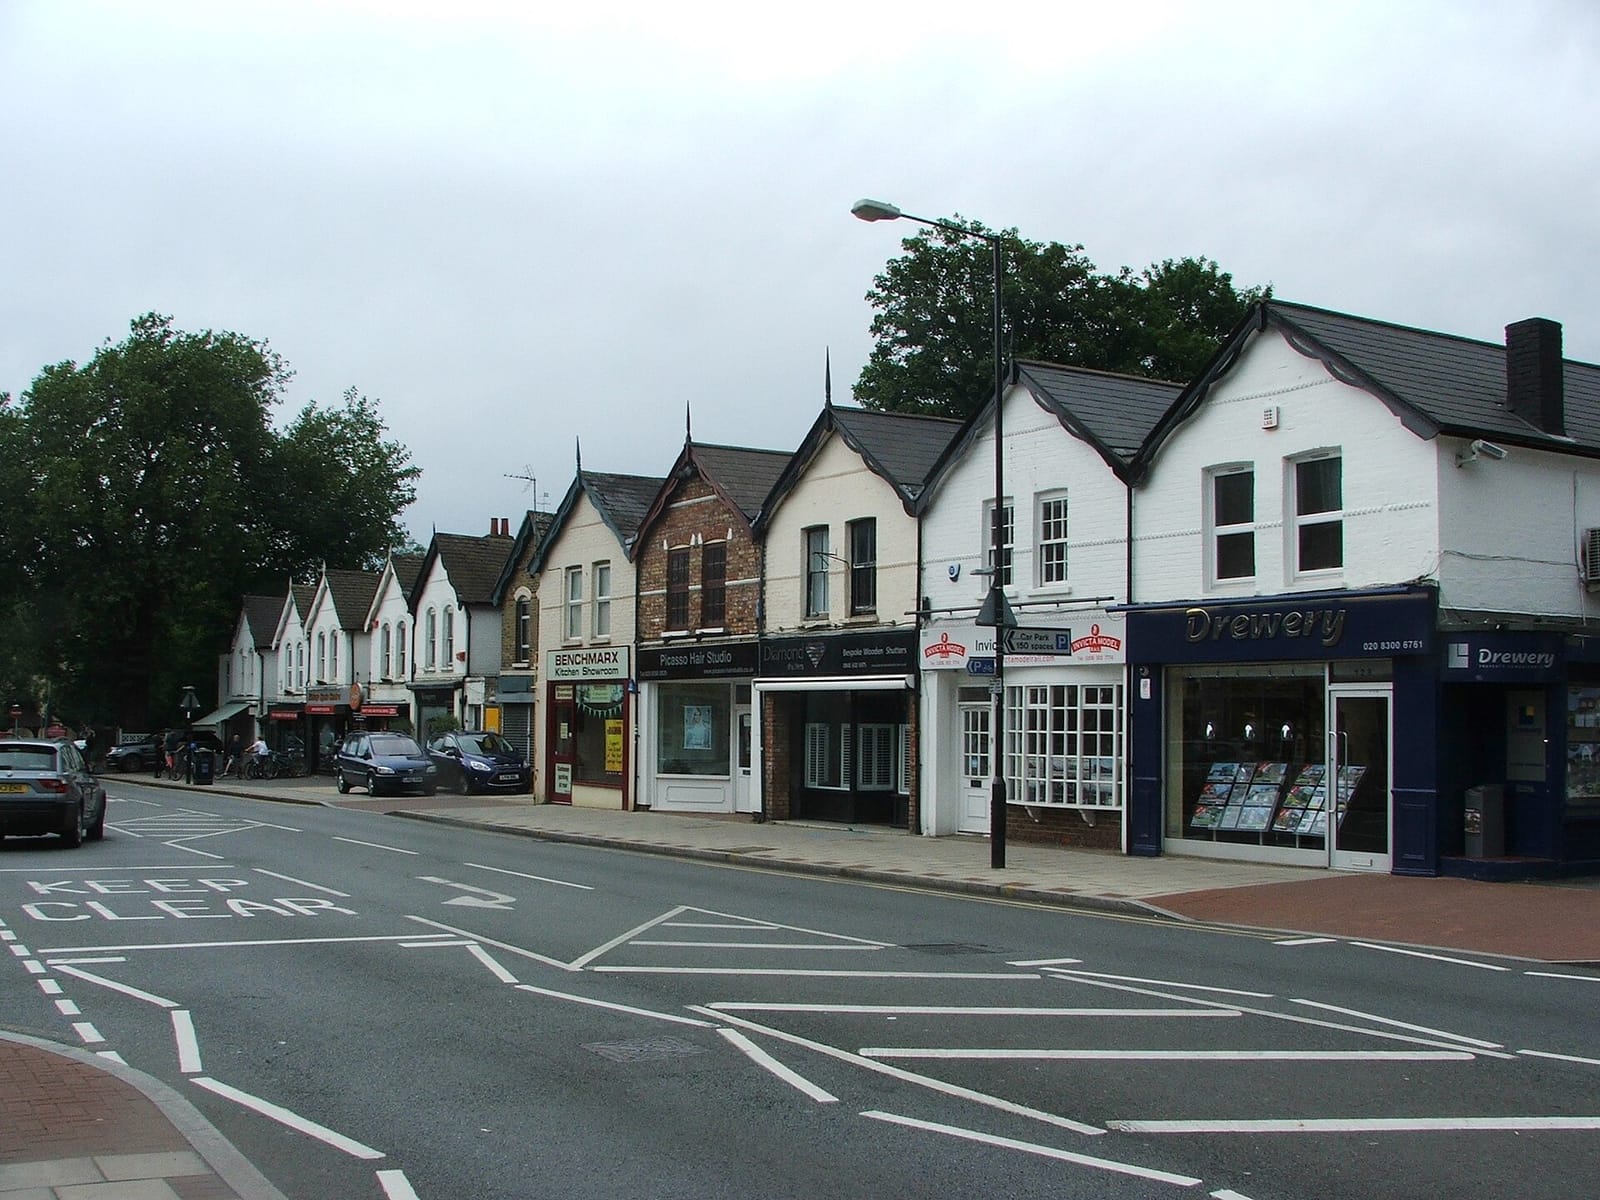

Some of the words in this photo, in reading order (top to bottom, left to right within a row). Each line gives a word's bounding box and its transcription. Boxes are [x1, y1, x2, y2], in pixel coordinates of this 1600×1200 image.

[1185, 607, 1347, 647] Drewery
[1016, 642, 1028, 650] 150
[1031, 642, 1054, 651] spaces
[1072, 637, 1096, 650] INVICTA
[1097, 637, 1119, 649] MODEL
[1363, 642, 1378, 650] 020
[555, 651, 619, 666] BENCHMARX
[660, 653, 688, 666] Picasso
[689, 651, 705, 665] Hair
[706, 650, 732, 664] Studio
[1479, 648, 1555, 668] Drewery
[555, 667, 580, 677] Kitchen
[582, 666, 619, 676] Showroom
[26, 878, 248, 895] KEEP
[22, 898, 358, 921] CLEAR
